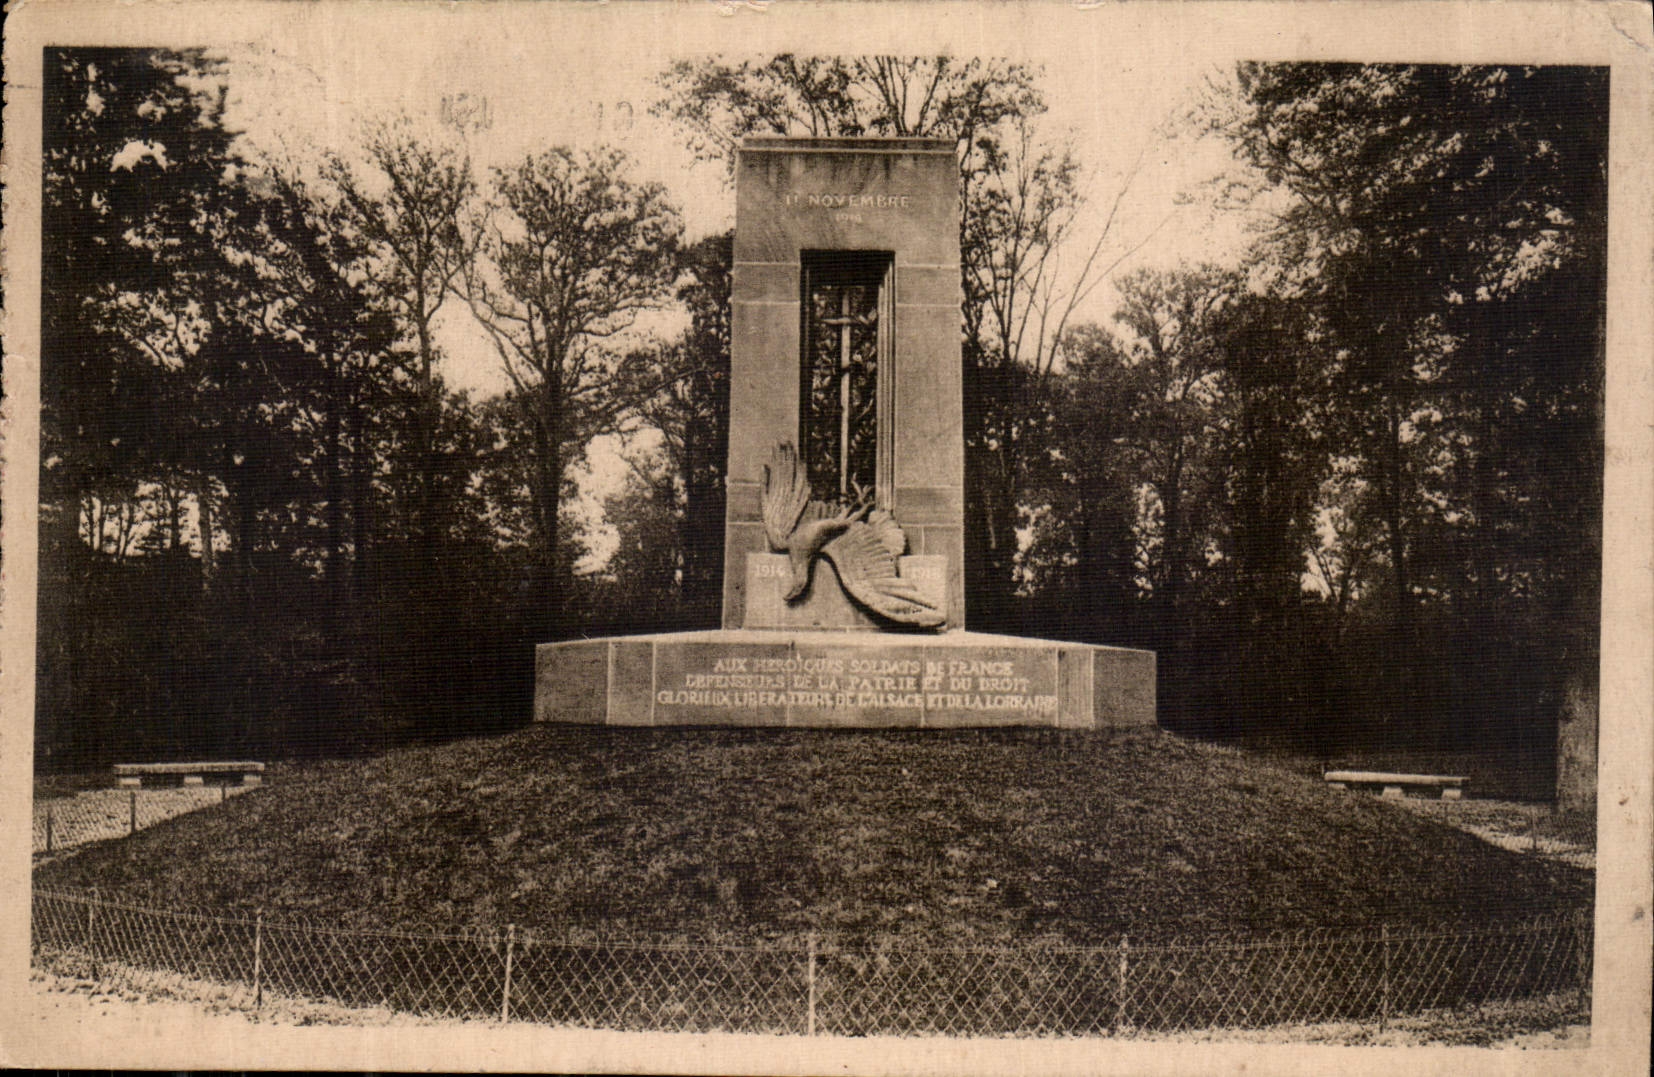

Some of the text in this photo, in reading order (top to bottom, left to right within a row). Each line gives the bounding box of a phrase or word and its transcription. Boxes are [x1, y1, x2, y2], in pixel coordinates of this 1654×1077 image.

[808, 193, 910, 208] NOVEMBRE
[713, 657, 748, 673] AUX
[850, 659, 920, 675] SOLDATS
[926, 661, 945, 676] DE
[948, 661, 1014, 676] FRANCE
[685, 674, 1030, 692] DEFENSEURS DE LA PATRIE ET DU DROIT
[656, 690, 731, 706] GLORIEUX
[836, 692, 855, 707] DE
[926, 693, 944, 708] ET
[965, 694, 984, 710] LA
